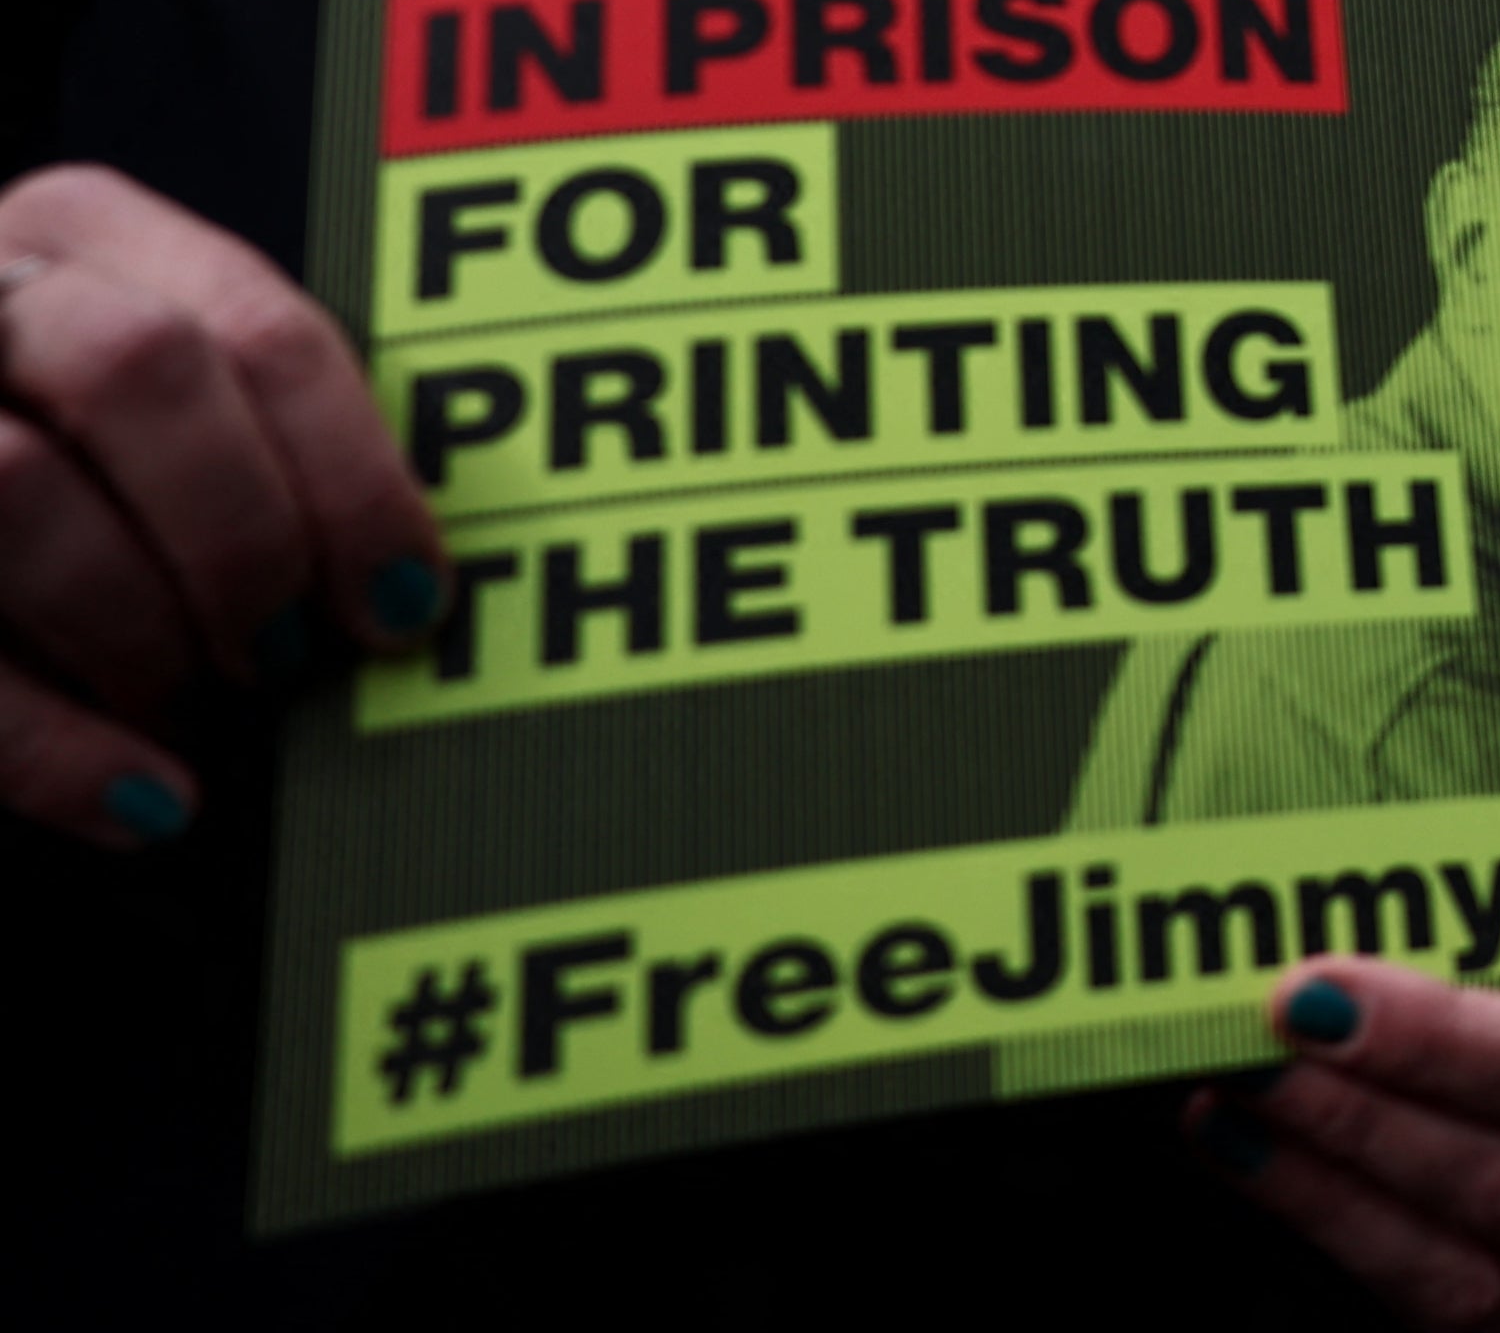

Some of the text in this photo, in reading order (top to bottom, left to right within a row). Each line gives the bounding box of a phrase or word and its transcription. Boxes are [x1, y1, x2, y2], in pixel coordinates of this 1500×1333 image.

[412, 157, 804, 301] FOR
[411, 308, 1313, 490] PRINTING
[850, 477, 1448, 630] TRUTH
